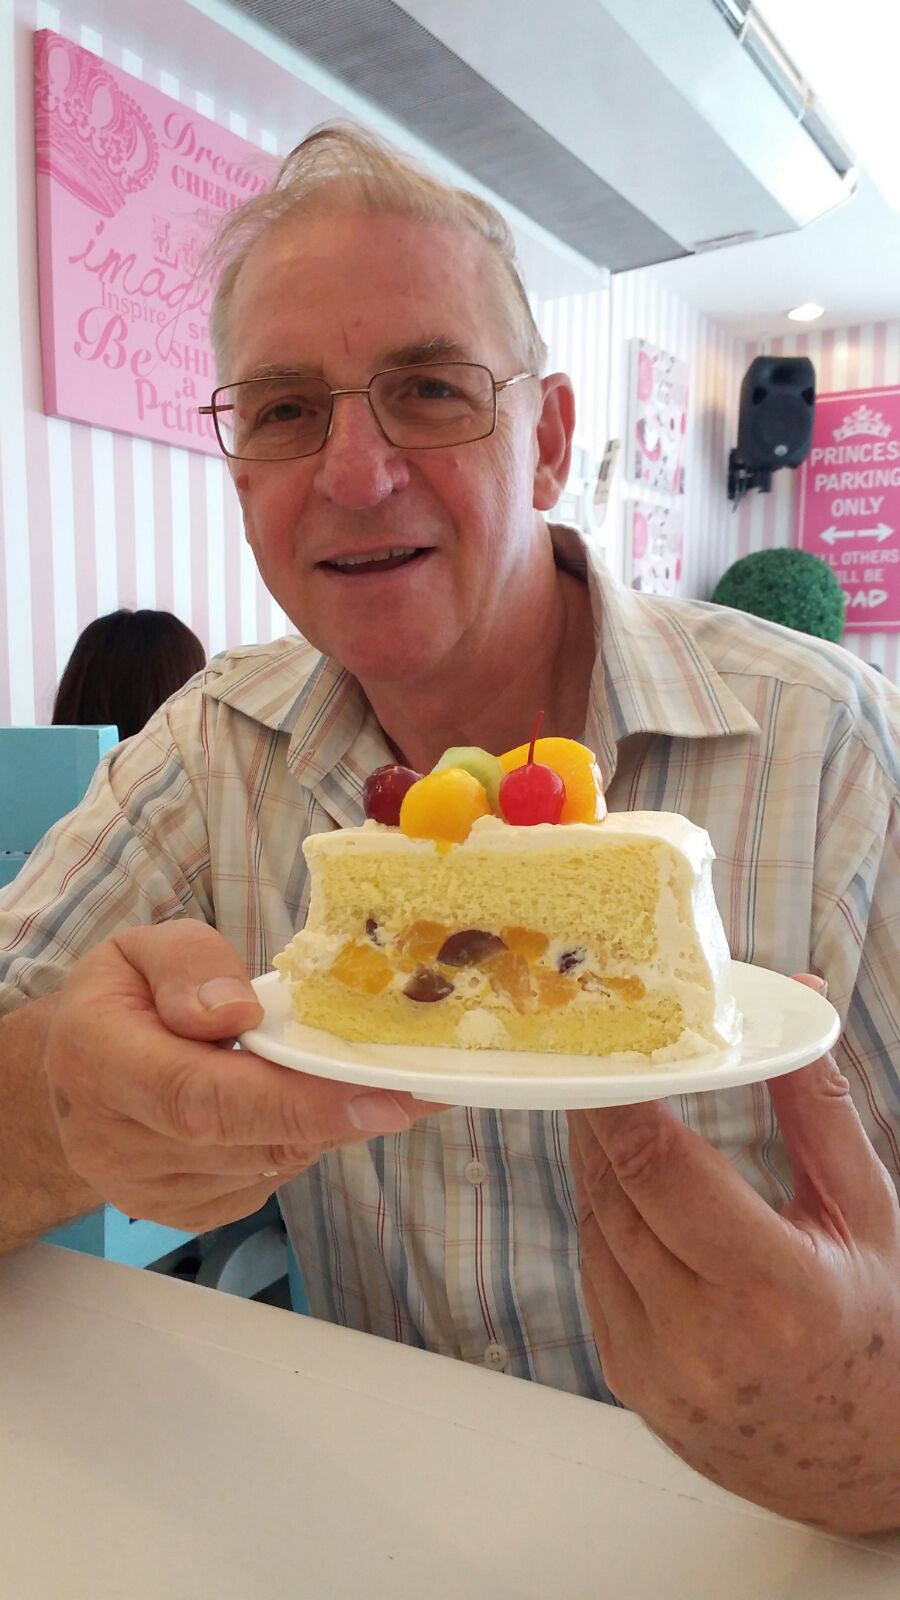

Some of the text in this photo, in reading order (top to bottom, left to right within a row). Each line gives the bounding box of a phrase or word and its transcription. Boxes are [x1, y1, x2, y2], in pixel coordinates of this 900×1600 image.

[160, 112, 268, 193] Dream
[101, 281, 167, 328] Inspire
[74, 306, 158, 377] Be
[168, 340, 209, 378] SHI
[182, 377, 198, 400] a
[810, 441, 900, 467] PRINCES
[814, 467, 900, 493] PARKING
[831, 495, 884, 518] ONLY
[841, 548, 899, 566] OTHERS
[863, 568, 885, 583] BE
